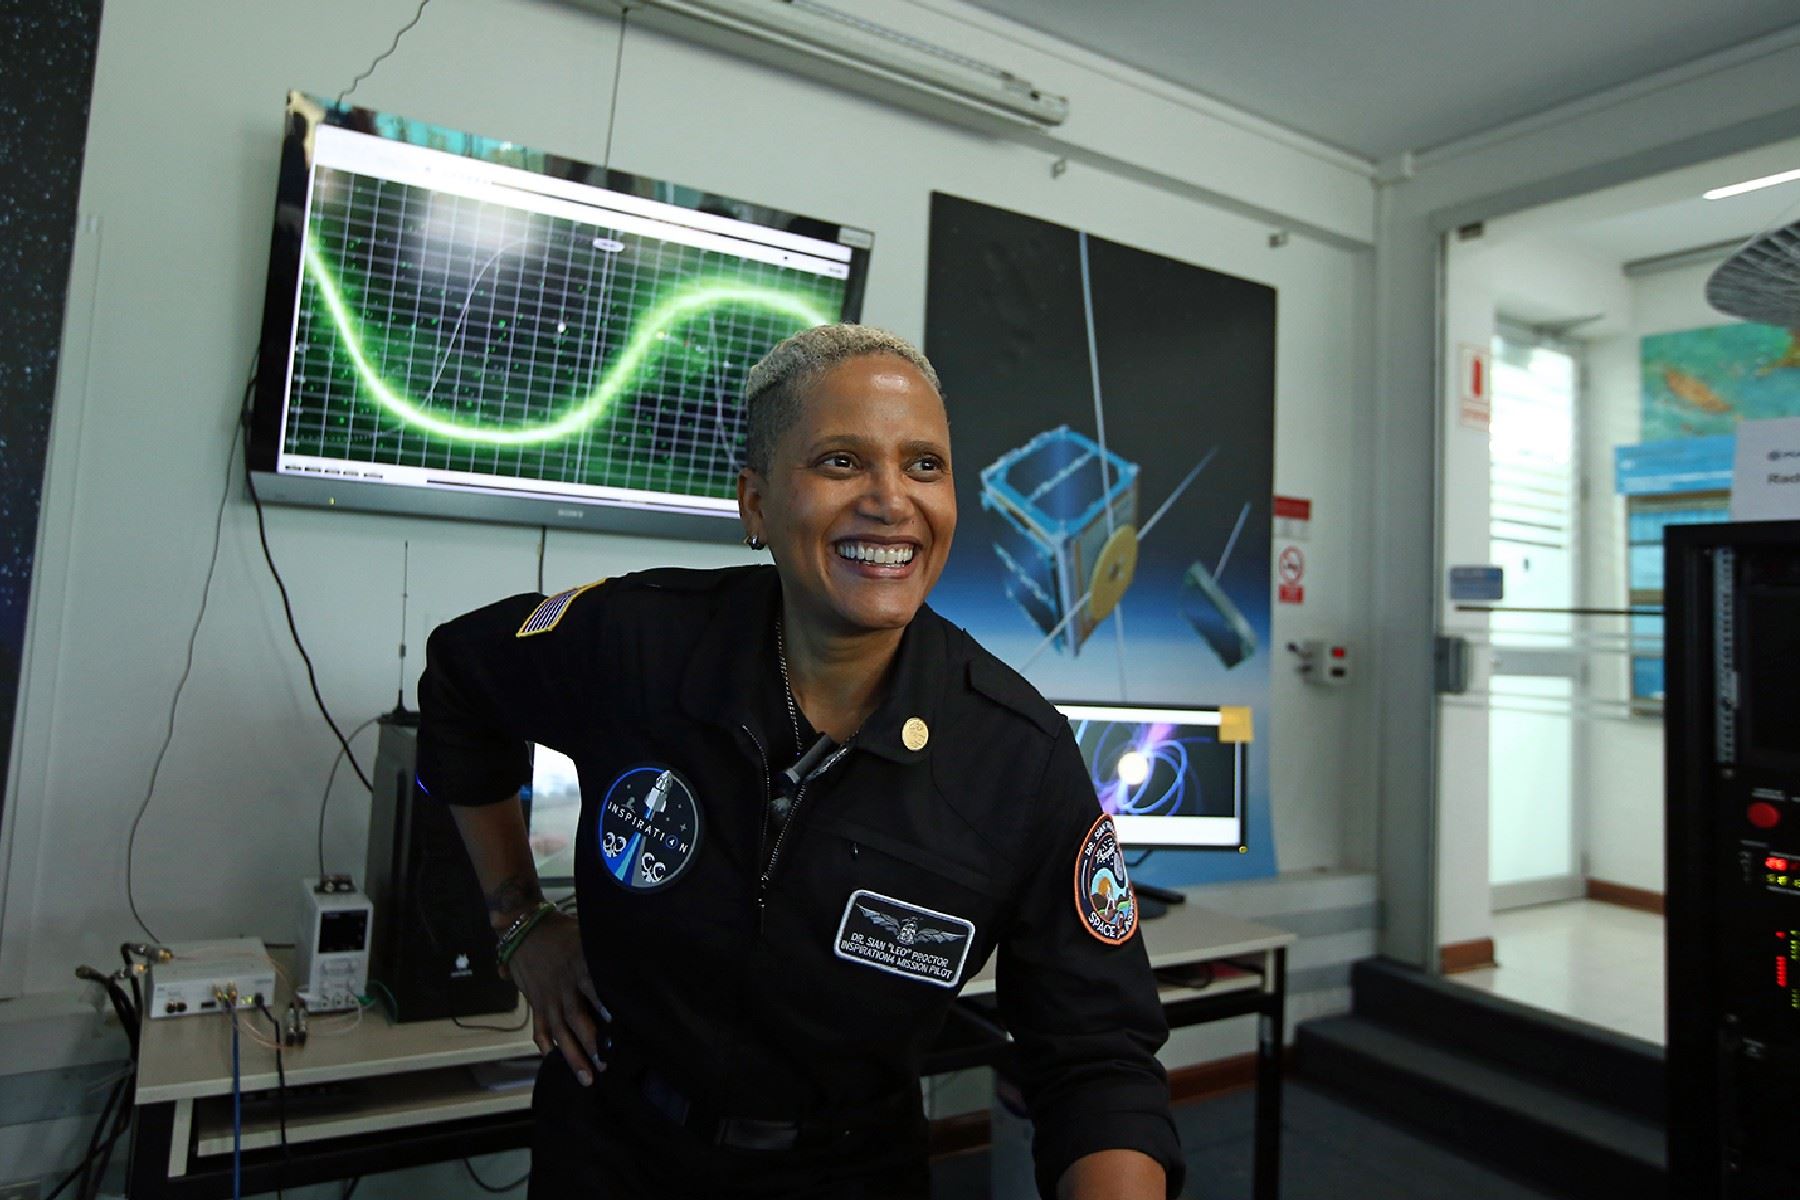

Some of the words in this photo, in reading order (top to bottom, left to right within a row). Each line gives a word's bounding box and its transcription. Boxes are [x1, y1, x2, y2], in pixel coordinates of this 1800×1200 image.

[896, 957, 928, 973] MISSION
[928, 964, 953, 979] PILOT
[911, 951, 949, 968] PROCTOR
